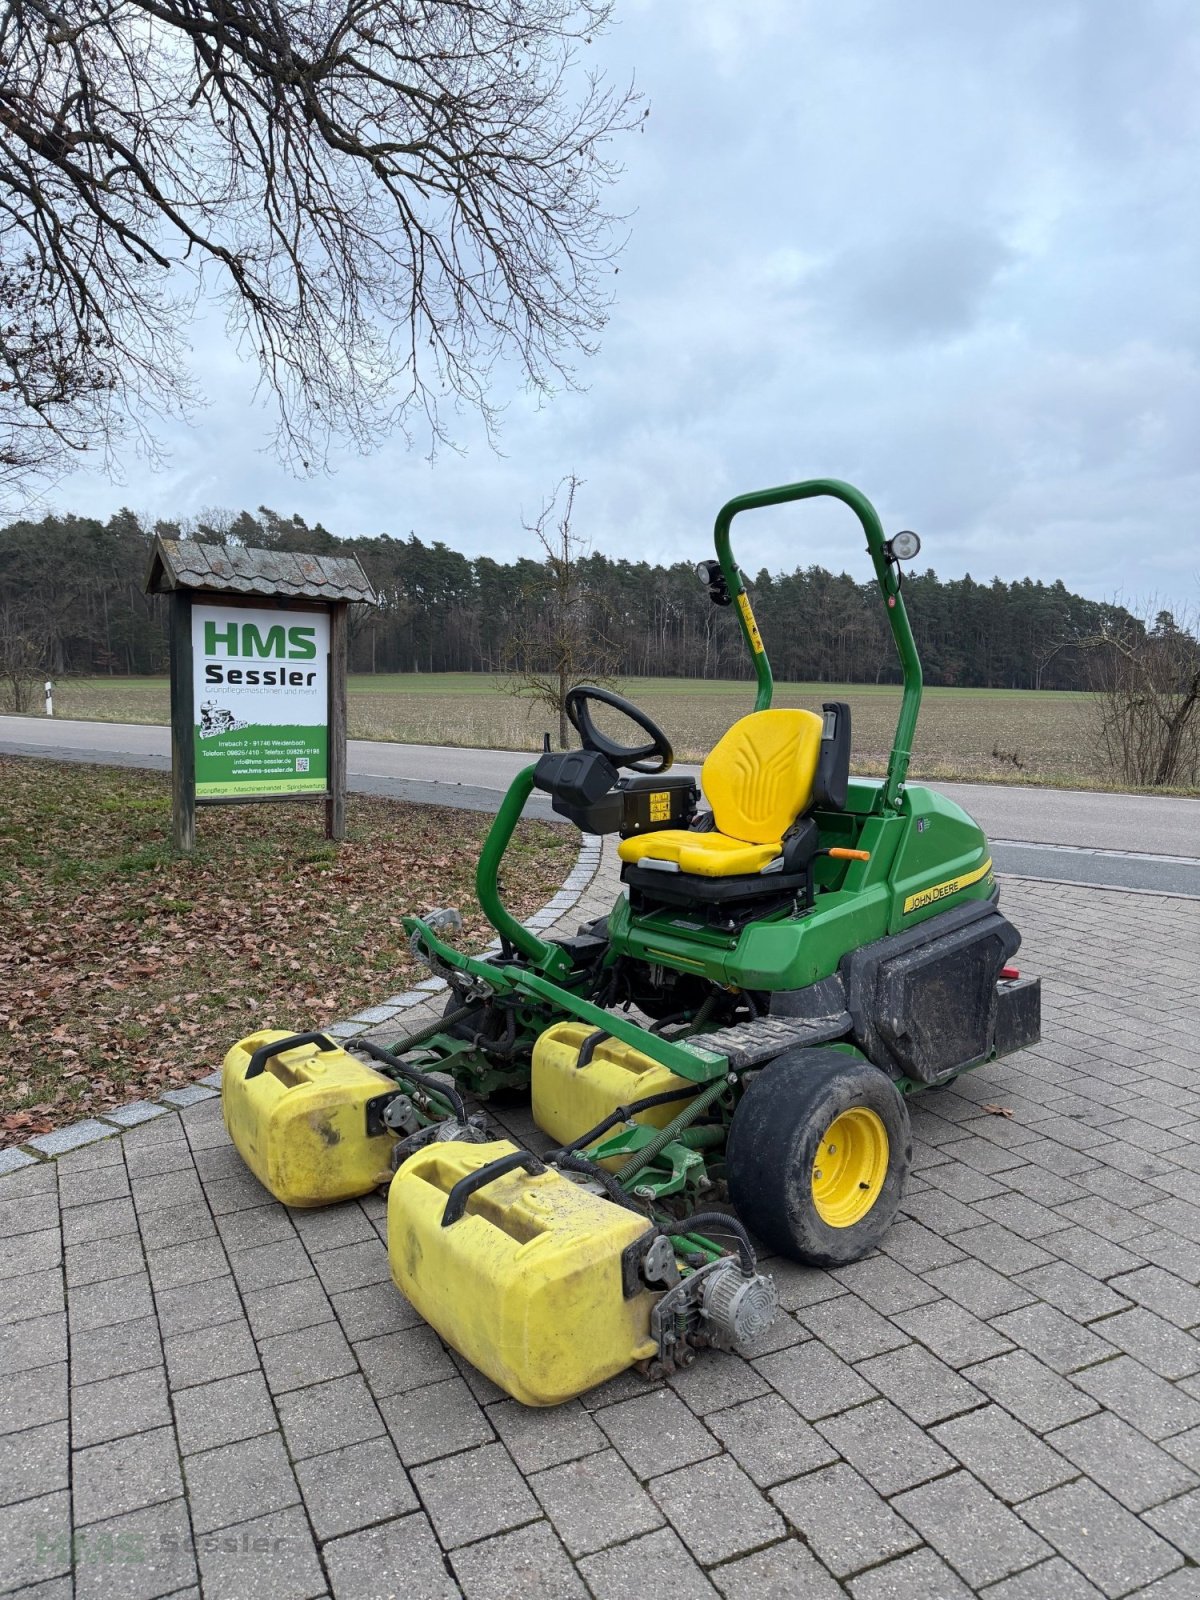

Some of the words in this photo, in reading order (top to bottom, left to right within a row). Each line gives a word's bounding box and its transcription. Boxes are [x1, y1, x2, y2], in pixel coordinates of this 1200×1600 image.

[205, 621, 317, 660] HMS
[205, 664, 317, 686] Sessler
[284, 687, 297, 695] und
[910, 892, 932, 910] JOHN
[932, 881, 959, 900] DEERE
